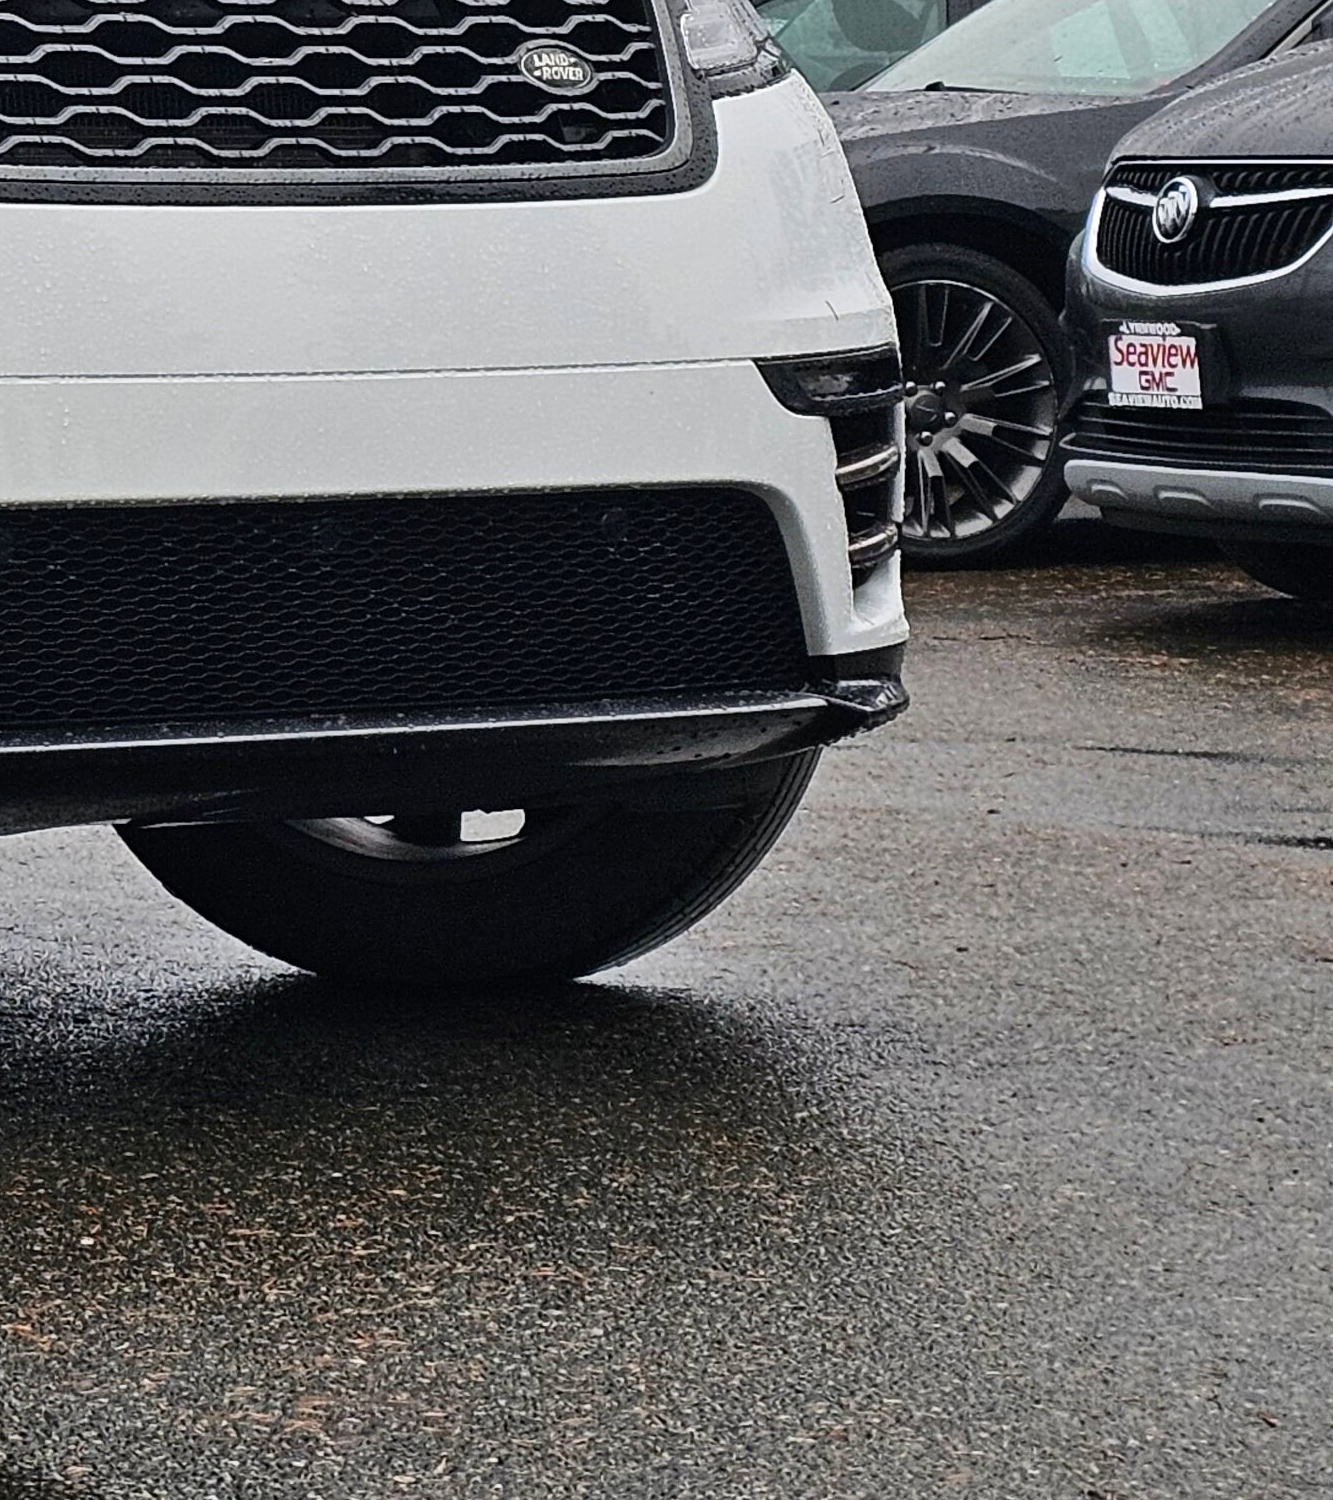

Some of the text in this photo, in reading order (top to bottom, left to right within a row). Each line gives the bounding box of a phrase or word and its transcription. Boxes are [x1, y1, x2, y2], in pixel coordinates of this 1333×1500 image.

[533, 52, 569, 68] LAND
[542, 66, 584, 81] ROVER
[1113, 335, 1197, 369] Seaview
[1138, 370, 1179, 392] GMC
